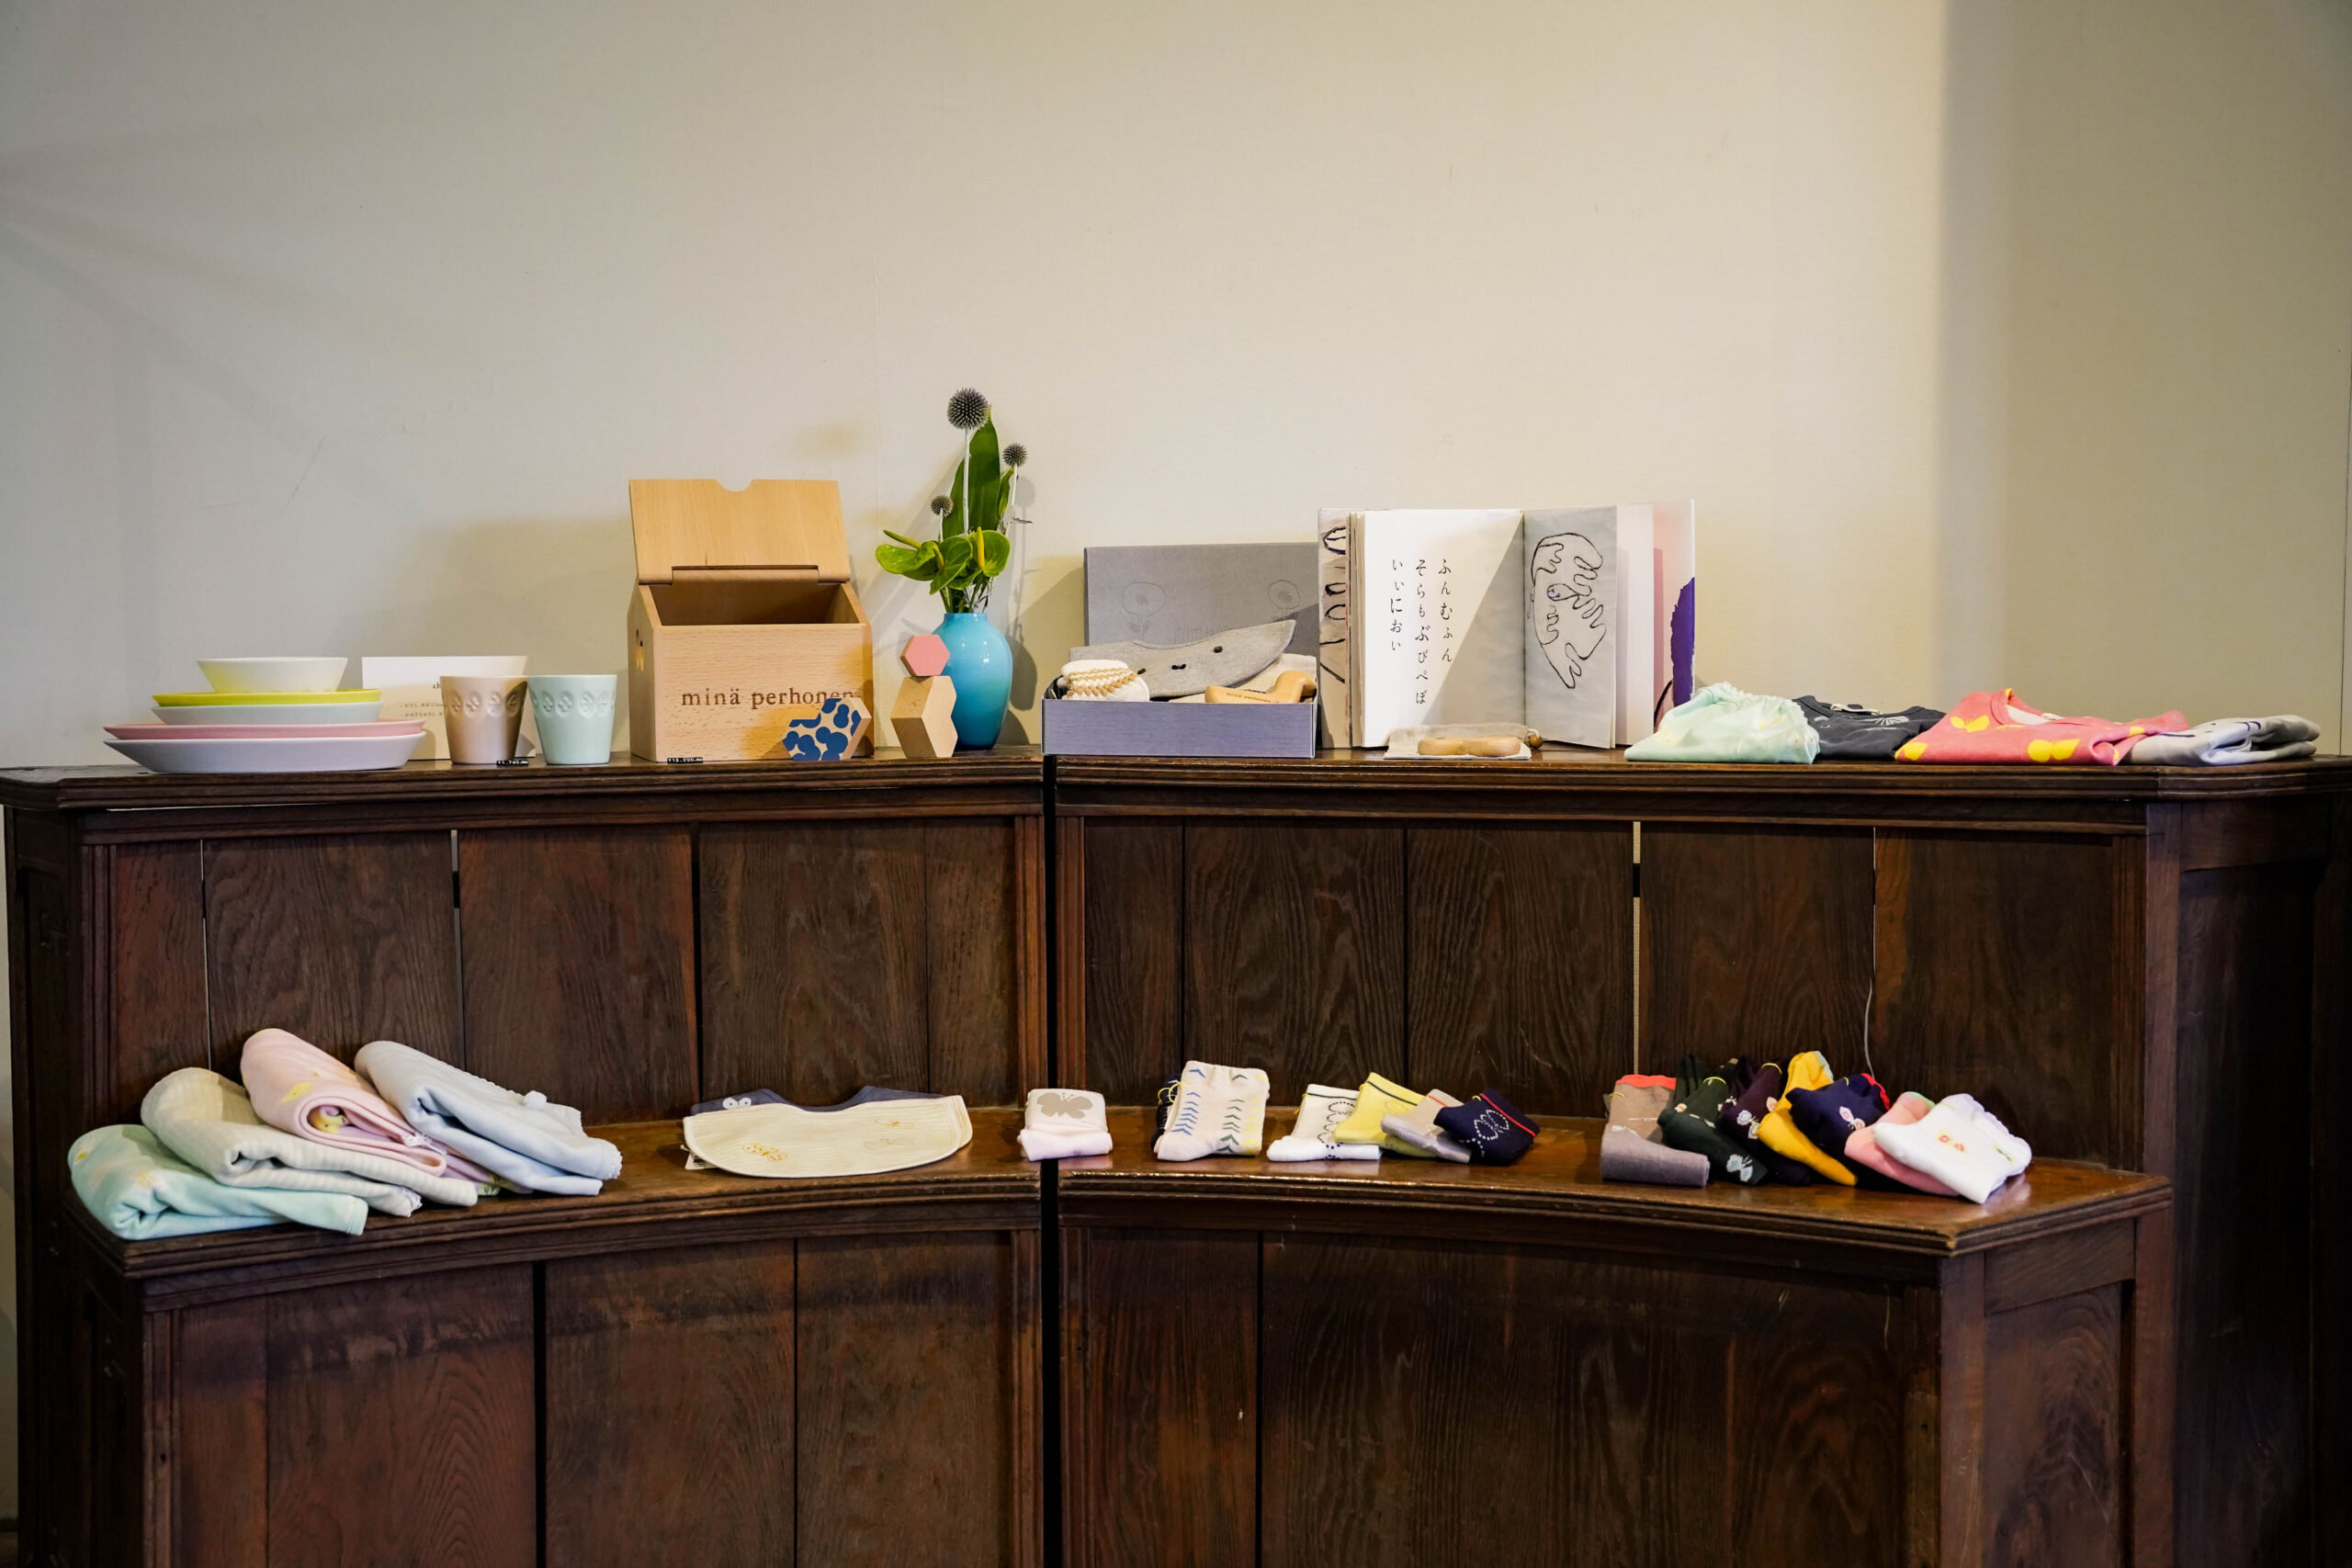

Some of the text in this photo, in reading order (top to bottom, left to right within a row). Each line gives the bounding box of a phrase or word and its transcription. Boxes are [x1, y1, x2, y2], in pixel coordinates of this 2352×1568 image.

[1390, 558, 1404, 651] いいにおい
[1438, 558, 1453, 662] ふんむふん
[681, 688, 741, 705] minä
